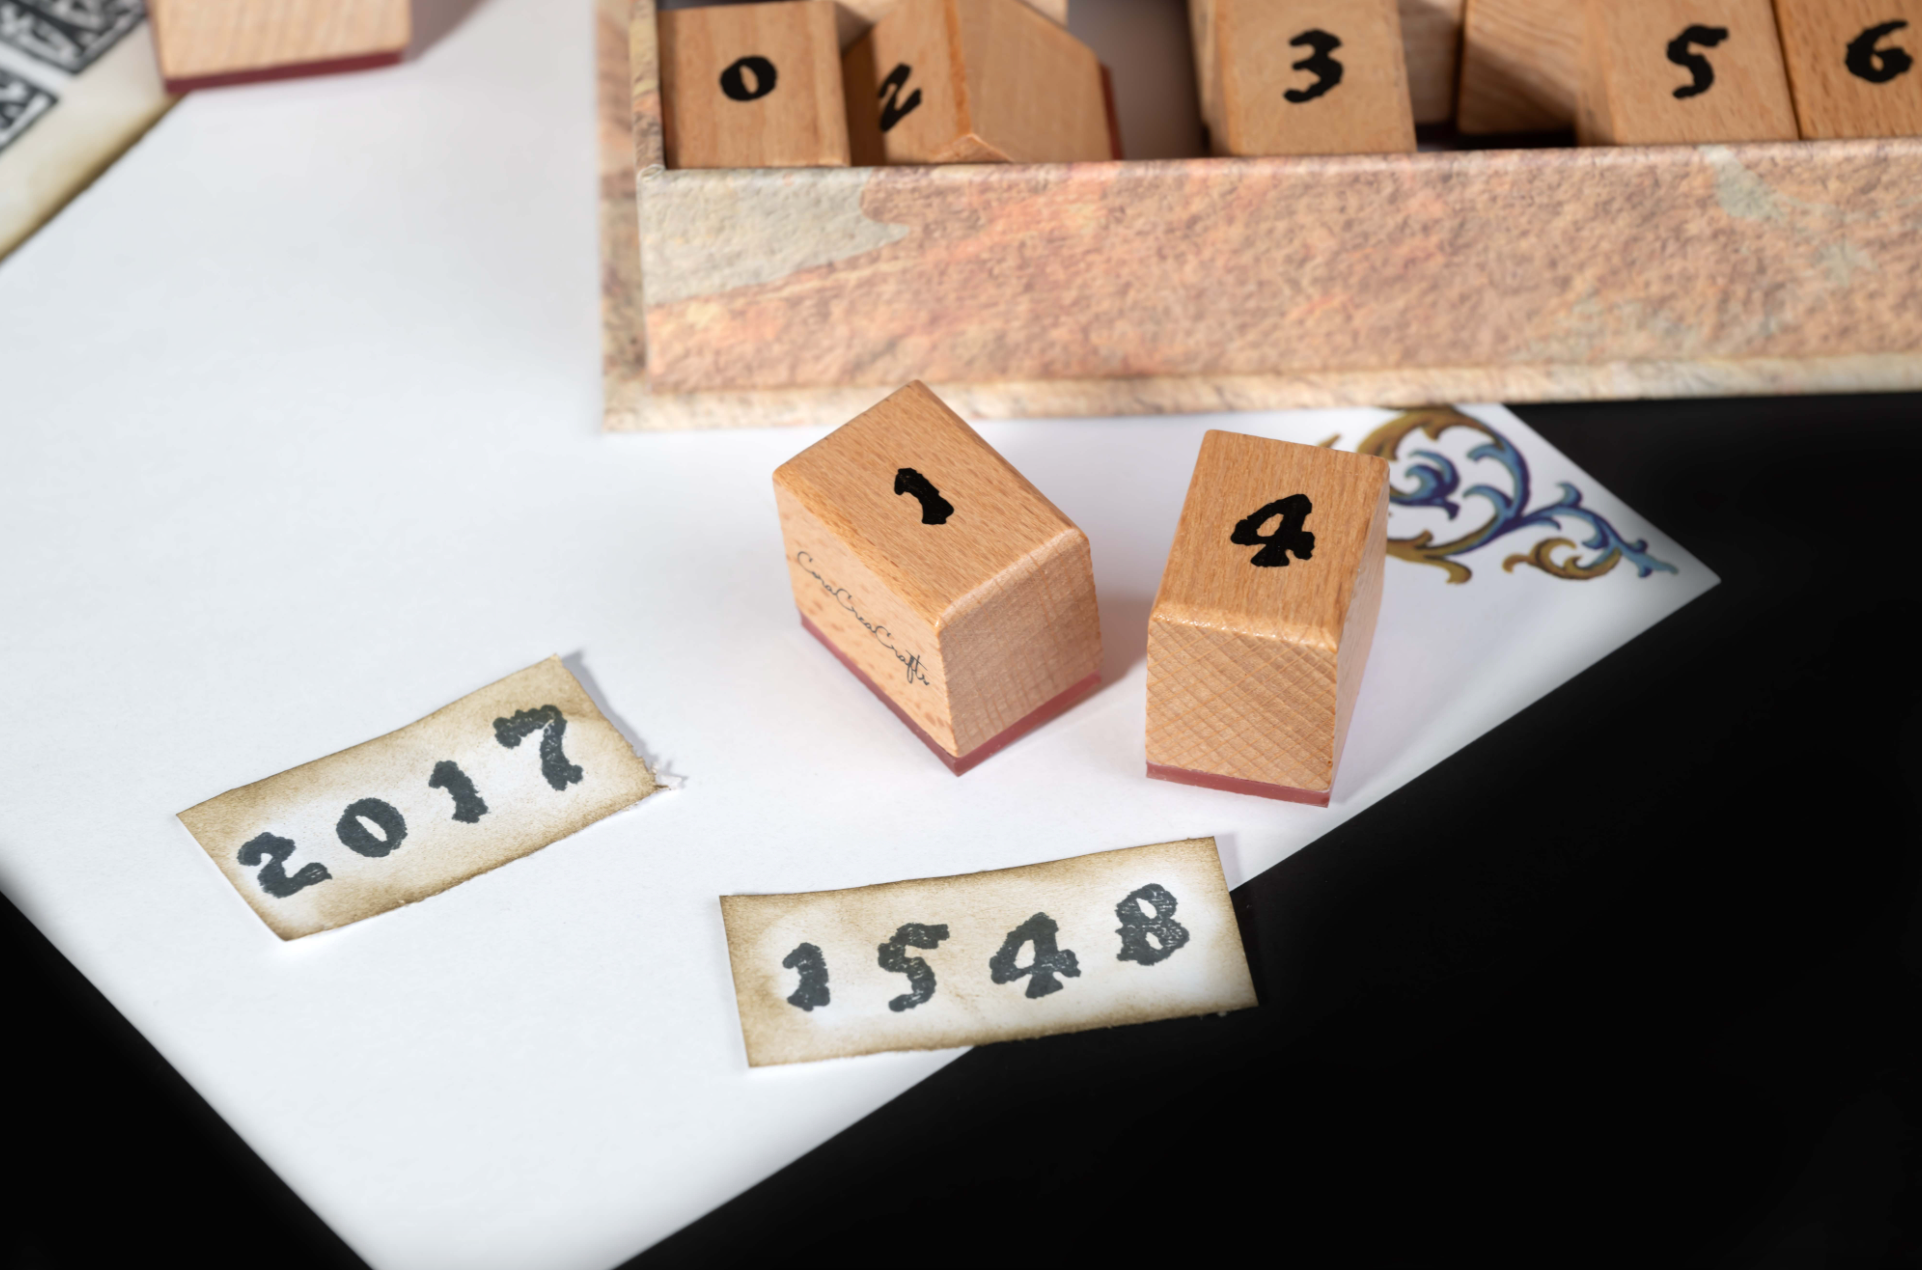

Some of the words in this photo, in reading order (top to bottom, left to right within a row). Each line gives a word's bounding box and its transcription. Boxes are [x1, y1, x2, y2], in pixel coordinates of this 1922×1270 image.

[719, 55, 777, 102] 0
[1283, 29, 1344, 104] 3
[1666, 24, 1729, 100] 5
[1844, 20, 1913, 84] 6
[878, 62, 922, 133] 2
[893, 467, 955, 526] 1
[1230, 493, 1316, 568] 4
